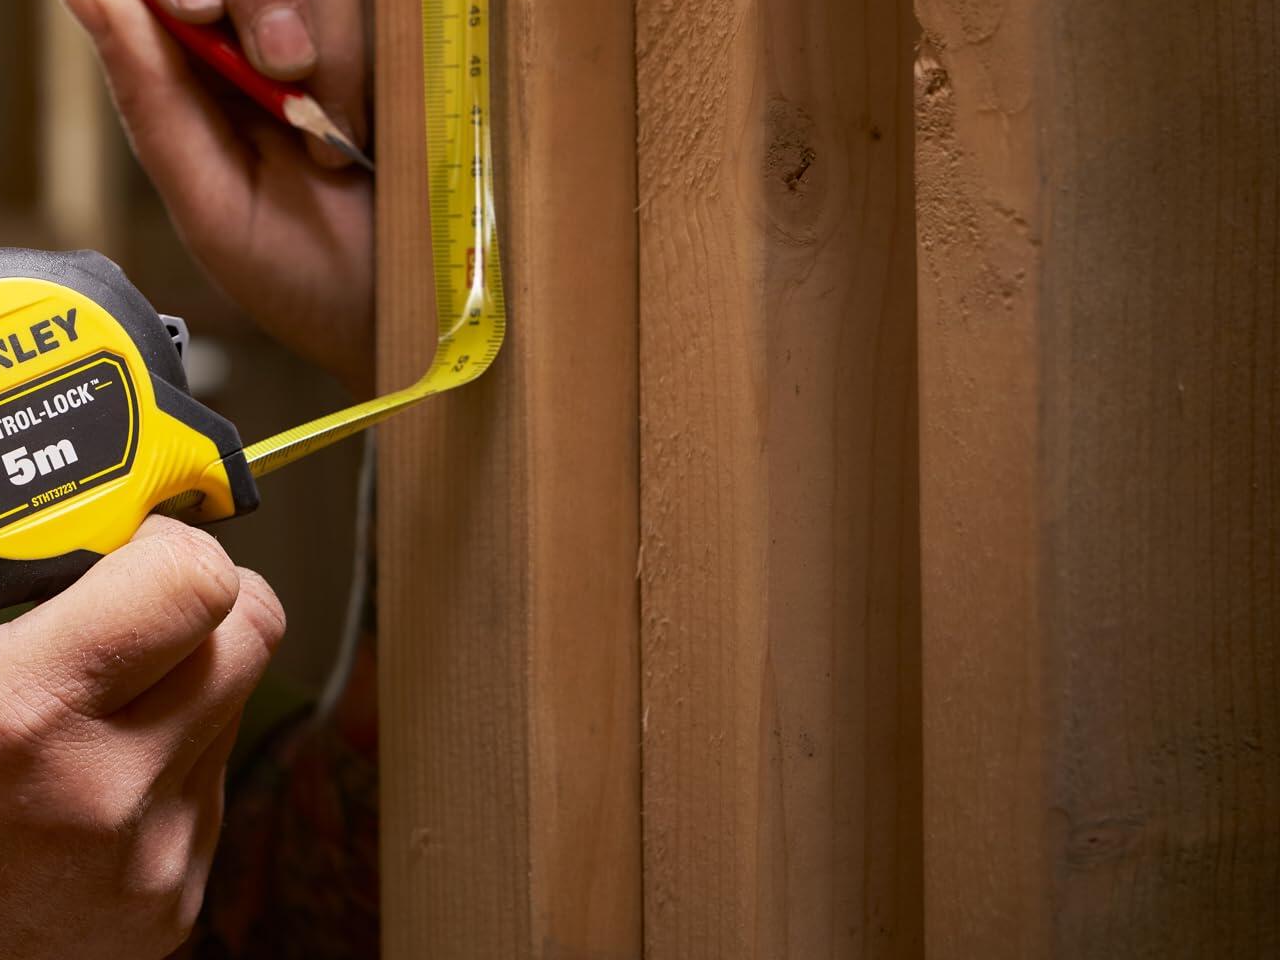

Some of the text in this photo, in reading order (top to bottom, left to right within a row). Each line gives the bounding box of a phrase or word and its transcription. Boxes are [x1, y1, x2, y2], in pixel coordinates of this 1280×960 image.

[468, 5, 481, 27] 45
[469, 56, 482, 77] 46
[468, 308, 481, 326] 51
[451, 355, 470, 373] 52
[1, 438, 79, 486] 5m
[31, 481, 78, 507] STHT37231
